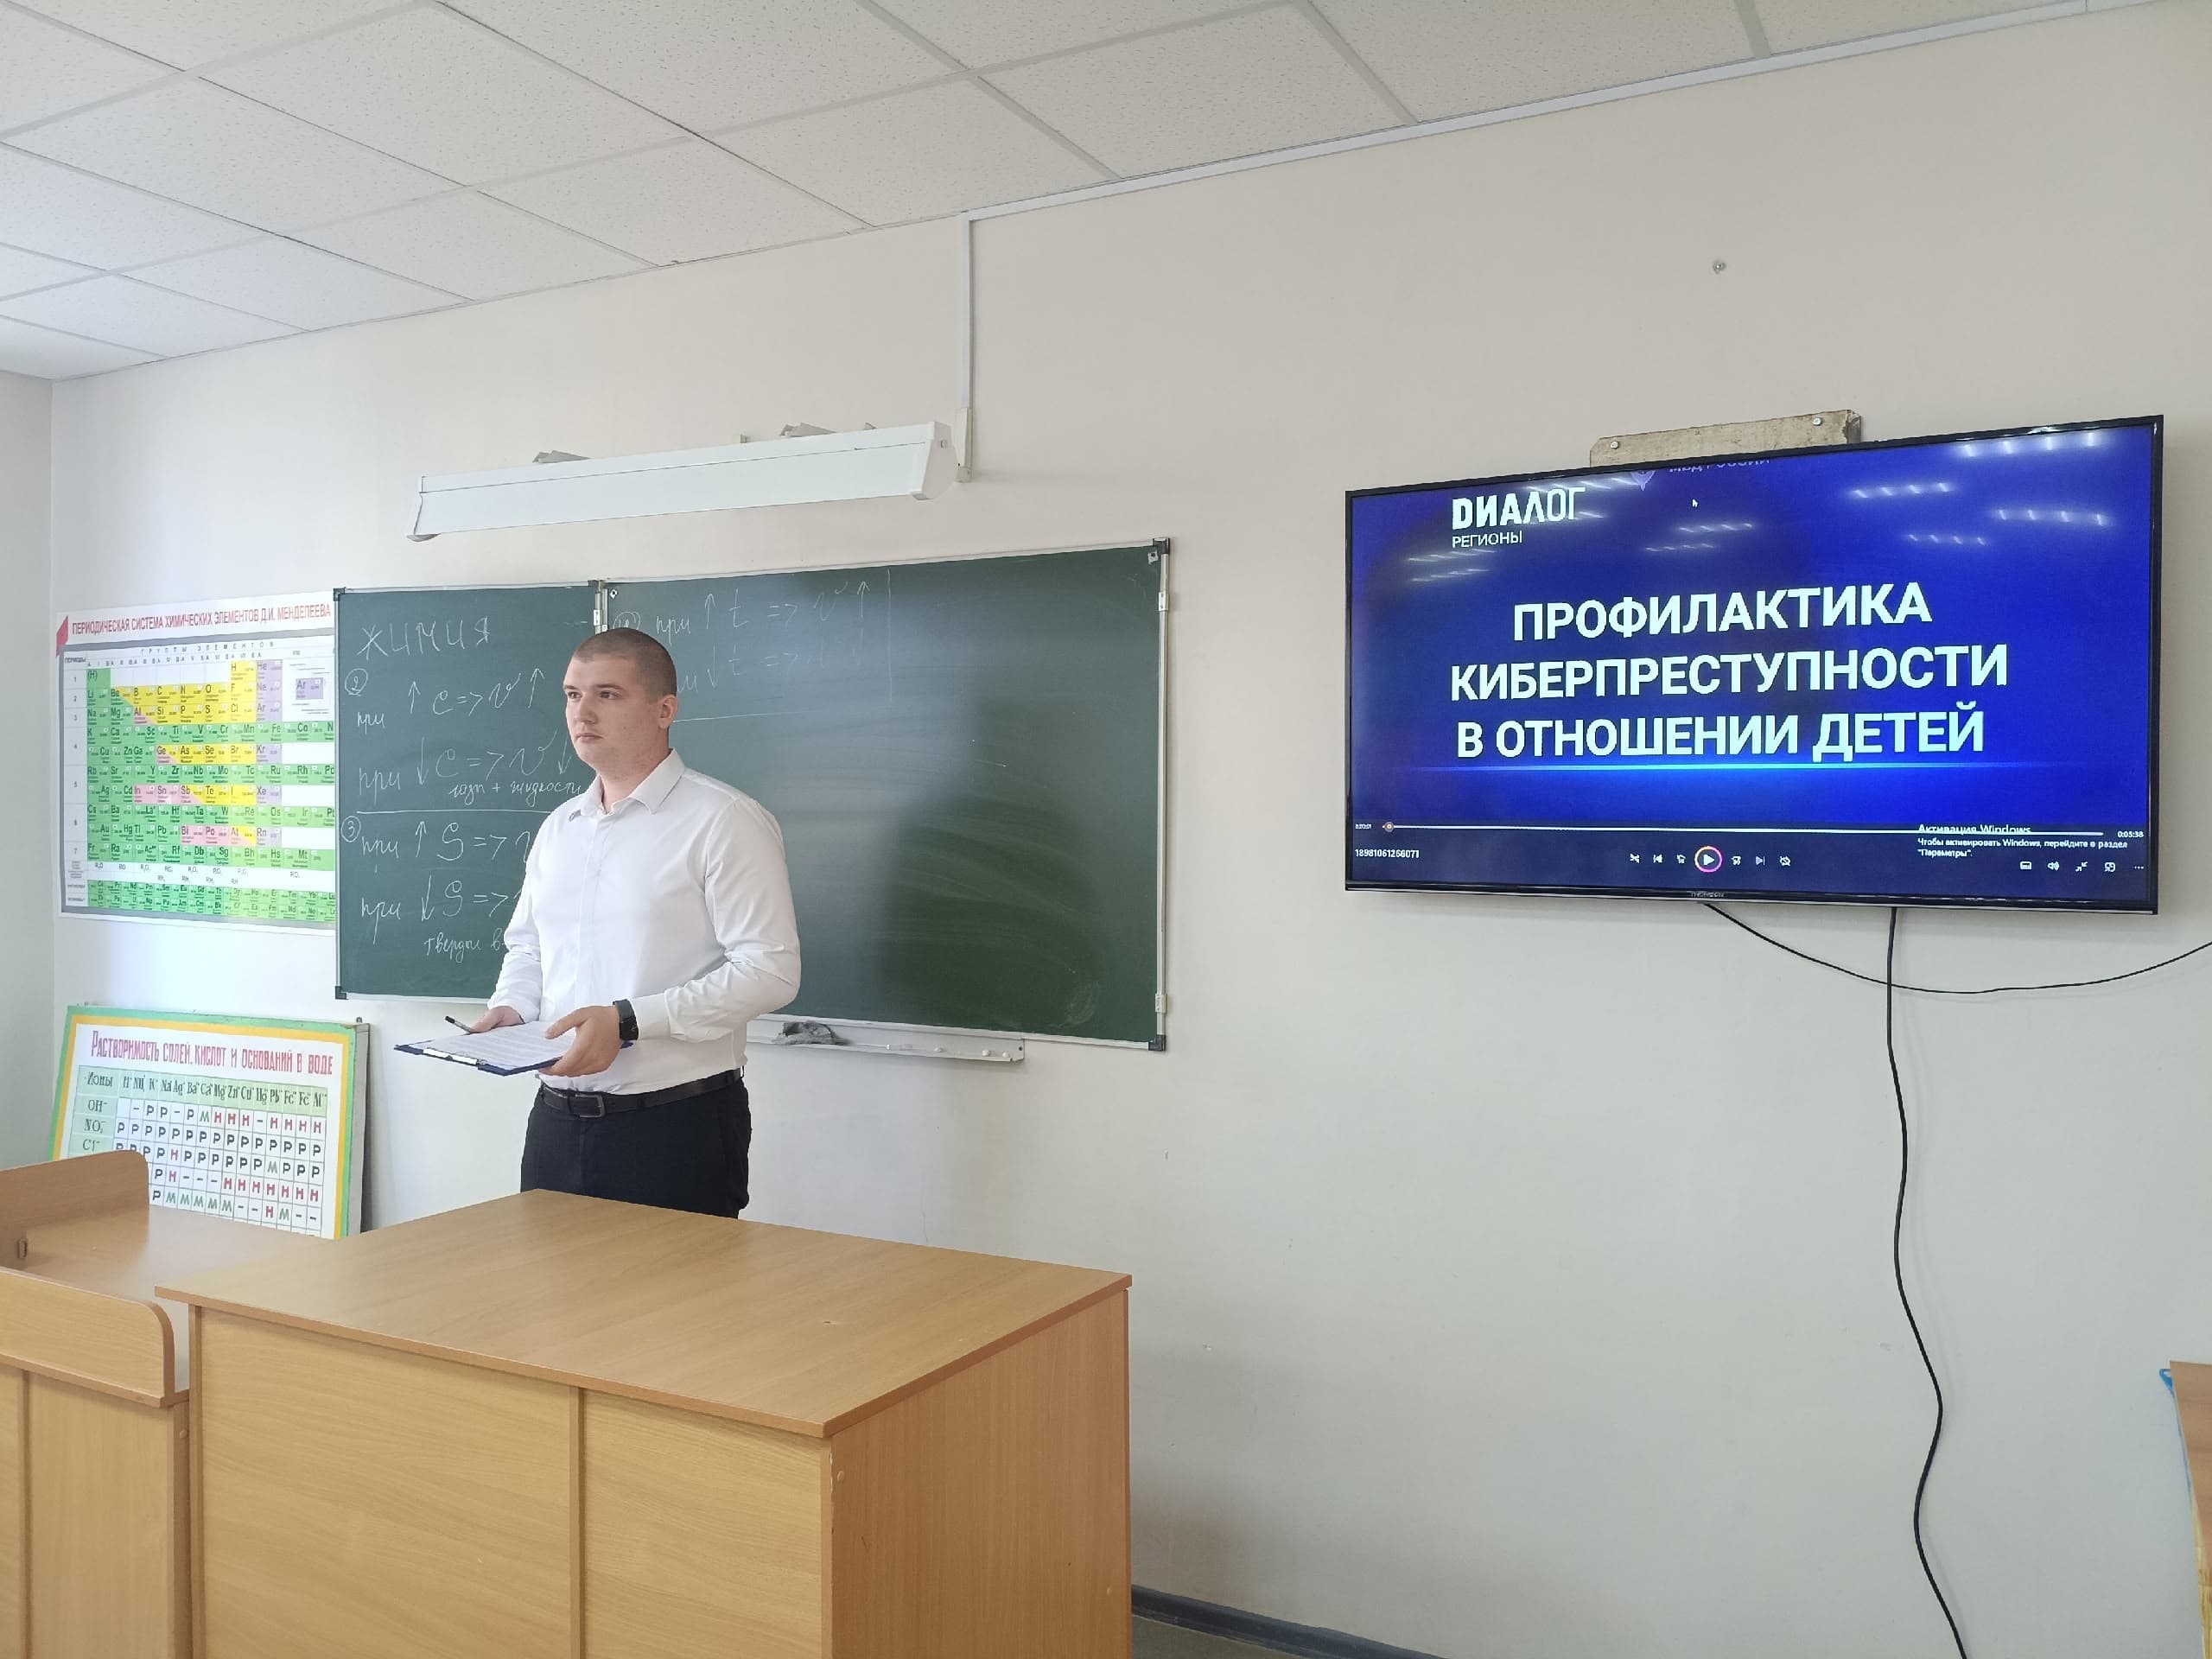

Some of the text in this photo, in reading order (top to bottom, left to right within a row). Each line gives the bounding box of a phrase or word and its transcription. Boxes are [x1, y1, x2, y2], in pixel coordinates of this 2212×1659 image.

[1452, 531, 1523, 548] РЕГИОНЫ
[73, 618, 130, 635] ПЕРИОДИЧЕСКАЯ
[131, 615, 163, 631] СИСТЕМА
[165, 611, 212, 628] ХИМИЧЕСКИХ
[214, 607, 259, 624] ЭЛЕМЕНТОВ
[277, 603, 331, 621] МЕНДЕЛЕЕВА
[1514, 582, 1932, 641] ПРОФИЛАКТИКА
[1450, 644, 2008, 702] КИБЕРПРЕСТУПНОСТИ
[1457, 701, 1984, 762] В ОТНОШЕНИИ ДЕТЕЙ
[1917, 837, 1943, 847] Чтобы
[1945, 837, 2001, 849] активировать
[2003, 838, 2042, 849] Windows,
[2044, 840, 2088, 850] перейдите
[2098, 841, 2128, 850] раздел
[1980, 823, 2031, 835] Windows
[194, 1044, 226, 1067] КИСЛОТ
[231, 1047, 238, 1068] И
[241, 1048, 293, 1072] ОСНОВАНИЙ
[296, 1052, 302, 1073] В
[308, 1054, 334, 1075] ВОДЕ
[86, 1071, 114, 1087] Ионы
[146, 1104, 321, 1134] Р Р Р М Н Н Н Н Н Н Н
[117, 1122, 321, 1156] Р Р Р Р Р Р Р Р Р Р Р Р Р Р Р
